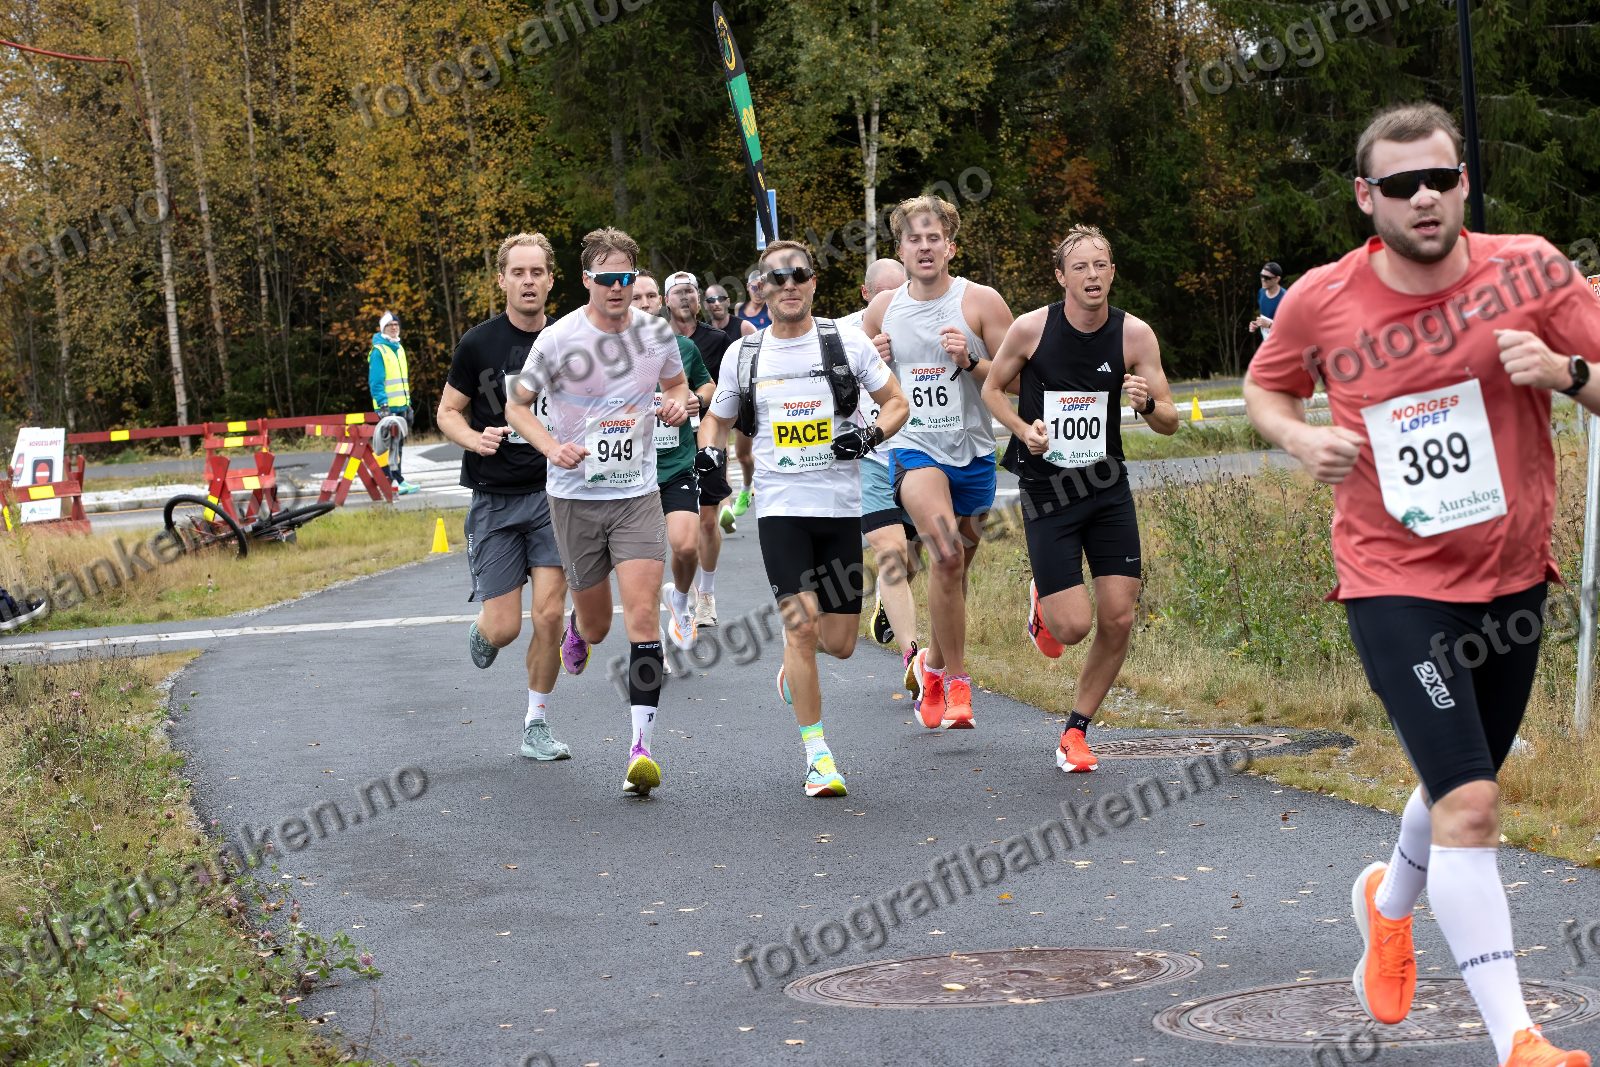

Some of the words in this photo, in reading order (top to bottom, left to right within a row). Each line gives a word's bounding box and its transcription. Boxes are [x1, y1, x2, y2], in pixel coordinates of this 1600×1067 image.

[911, 367, 947, 375] NORGES
[914, 374, 941, 382] LØPET
[783, 401, 821, 409] NORGES
[912, 385, 949, 407] 616
[786, 408, 816, 416] LØPET
[1391, 394, 1460, 422] NORGES
[600, 419, 635, 427] NORGES
[602, 427, 631, 435] LØPET
[1050, 416, 1101, 440] 1000
[1400, 409, 1450, 434] LØPET
[776, 421, 829, 445] PACE
[596, 438, 634, 463] 949
[798, 452, 834, 464] Aurskog
[1069, 449, 1104, 460] Aurskog
[1398, 432, 1472, 486] 389
[1438, 488, 1501, 514] Aurskog
[1413, 661, 1456, 709] 2XU
